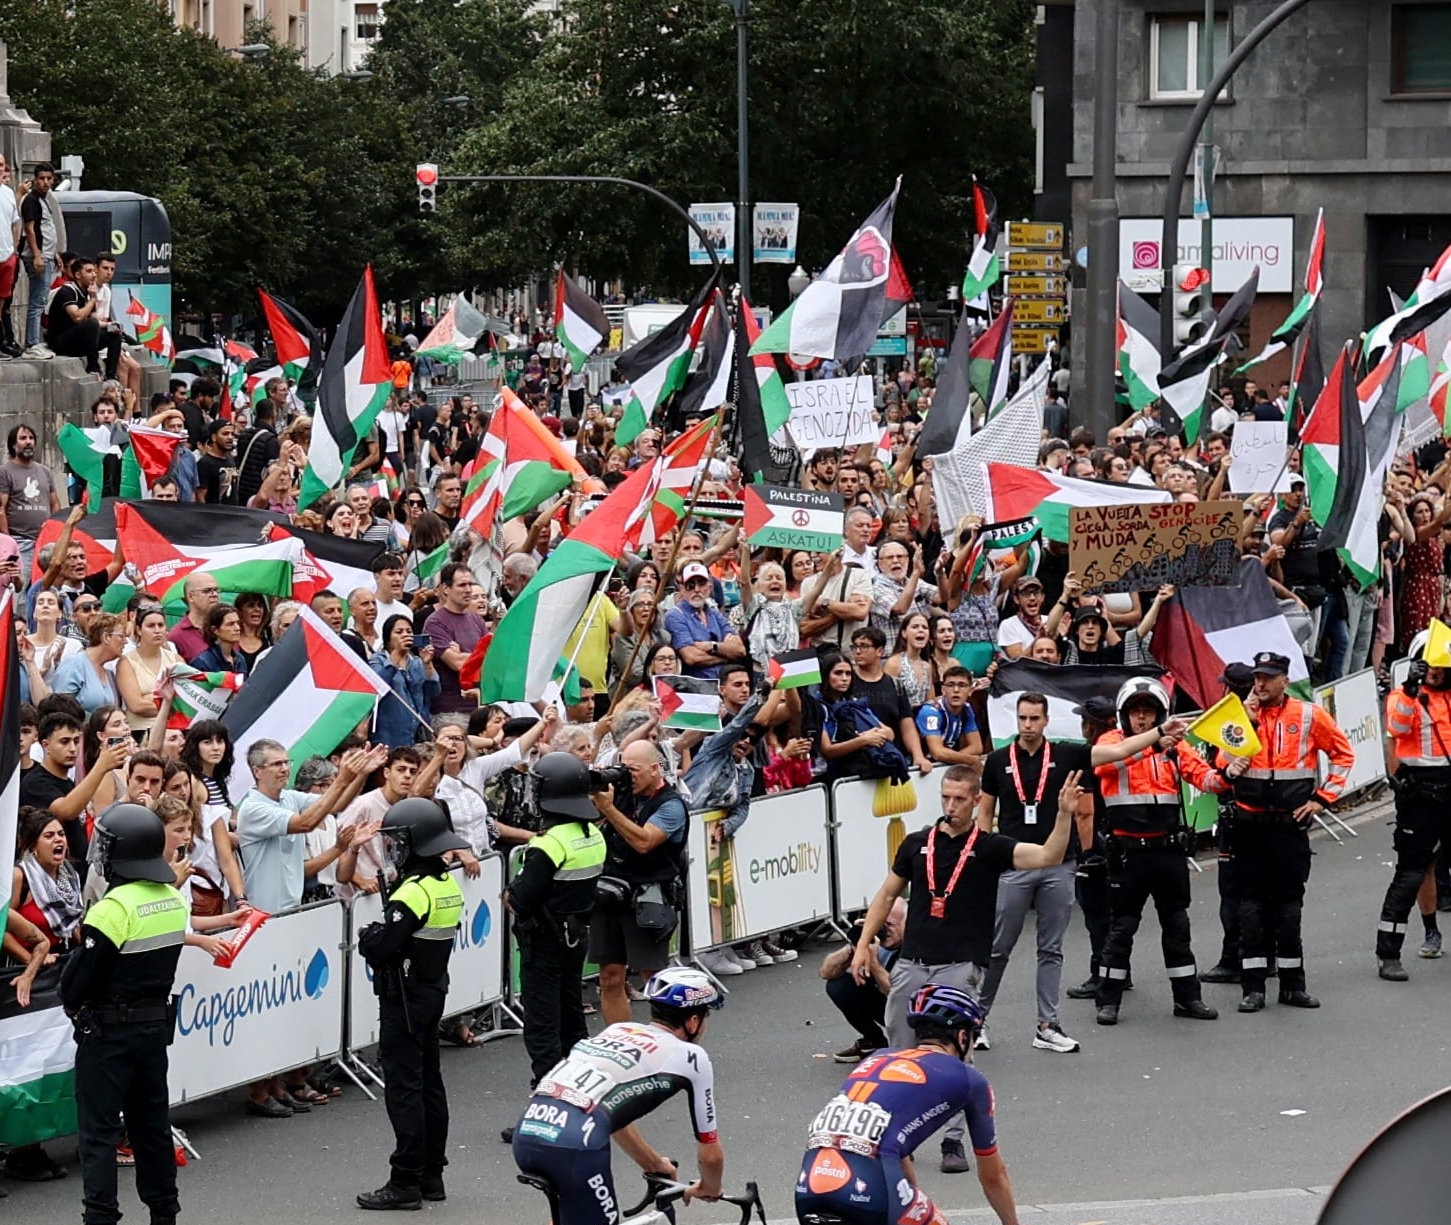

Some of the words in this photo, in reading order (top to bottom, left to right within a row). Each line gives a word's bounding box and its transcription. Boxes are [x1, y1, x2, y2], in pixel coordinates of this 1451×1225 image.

[790, 382, 868, 410] ISRAEL
[1076, 511, 1092, 523] LA
[1148, 502, 1197, 520] STOP
[766, 531, 833, 552] ASKATU!
[1085, 531, 1138, 551] MUDA
[749, 841, 822, 884] e-mobility
[177, 968, 302, 1047] Capgemini
[595, 1038, 643, 1064] ORA
[573, 1068, 608, 1094] 47
[602, 1076, 671, 1111] hansgrohe
[524, 1103, 569, 1128] BORA
[704, 1088, 715, 1124] BORA
[809, 1105, 842, 1135] 96
[902, 1117, 923, 1137] HANS
[922, 1101, 951, 1122] ANDERS
[842, 1107, 886, 1141] 196
[814, 1165, 846, 1180] postnl
[587, 1173, 618, 1225] BORA
